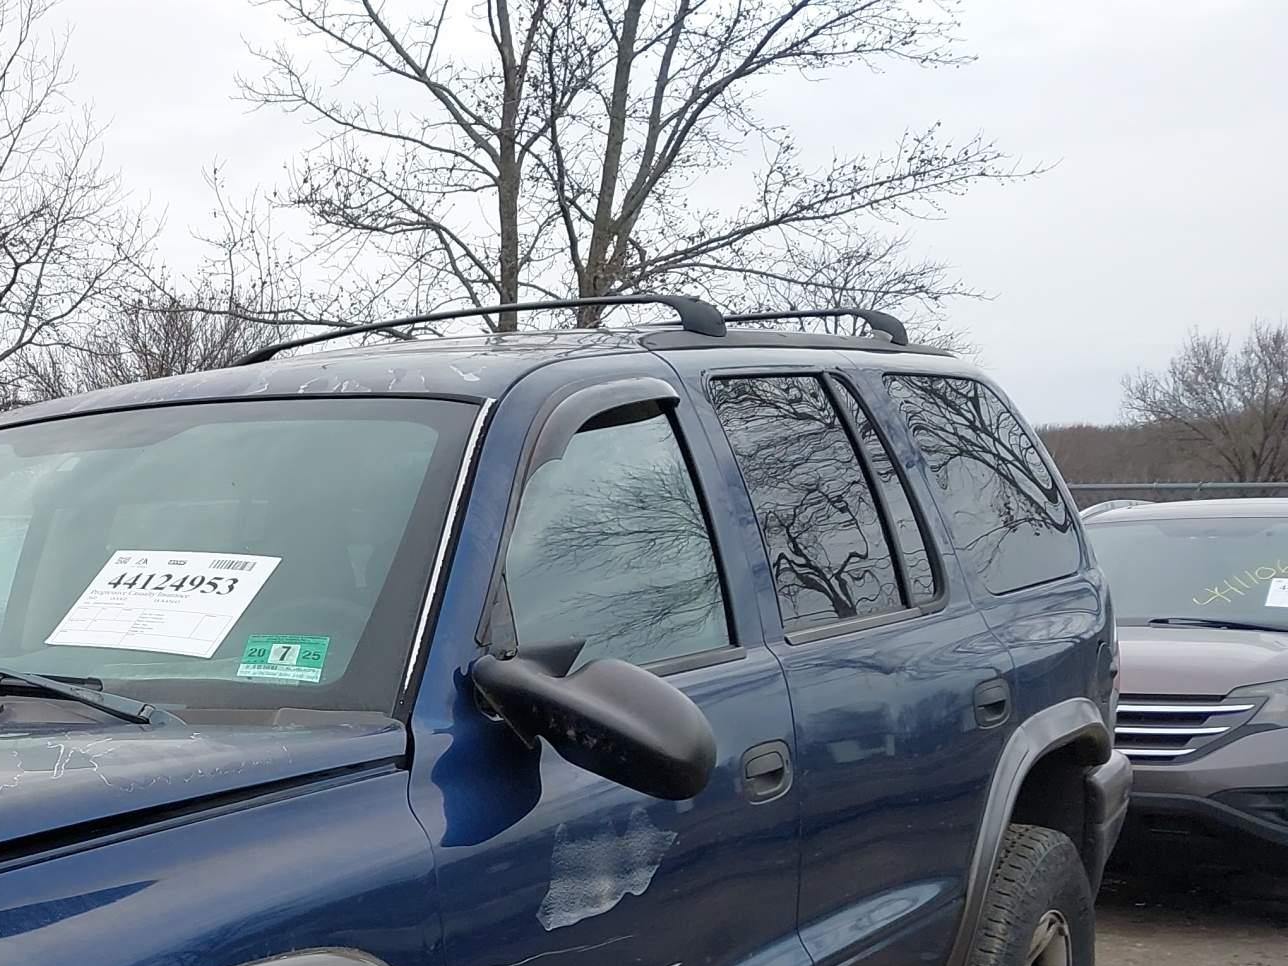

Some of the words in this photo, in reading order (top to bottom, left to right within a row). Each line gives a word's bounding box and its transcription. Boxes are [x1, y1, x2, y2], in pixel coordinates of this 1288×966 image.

[107, 571, 239, 596] 44124953
[247, 647, 267, 658] 20
[279, 645, 292, 662] 7
[302, 650, 321, 661] 25
